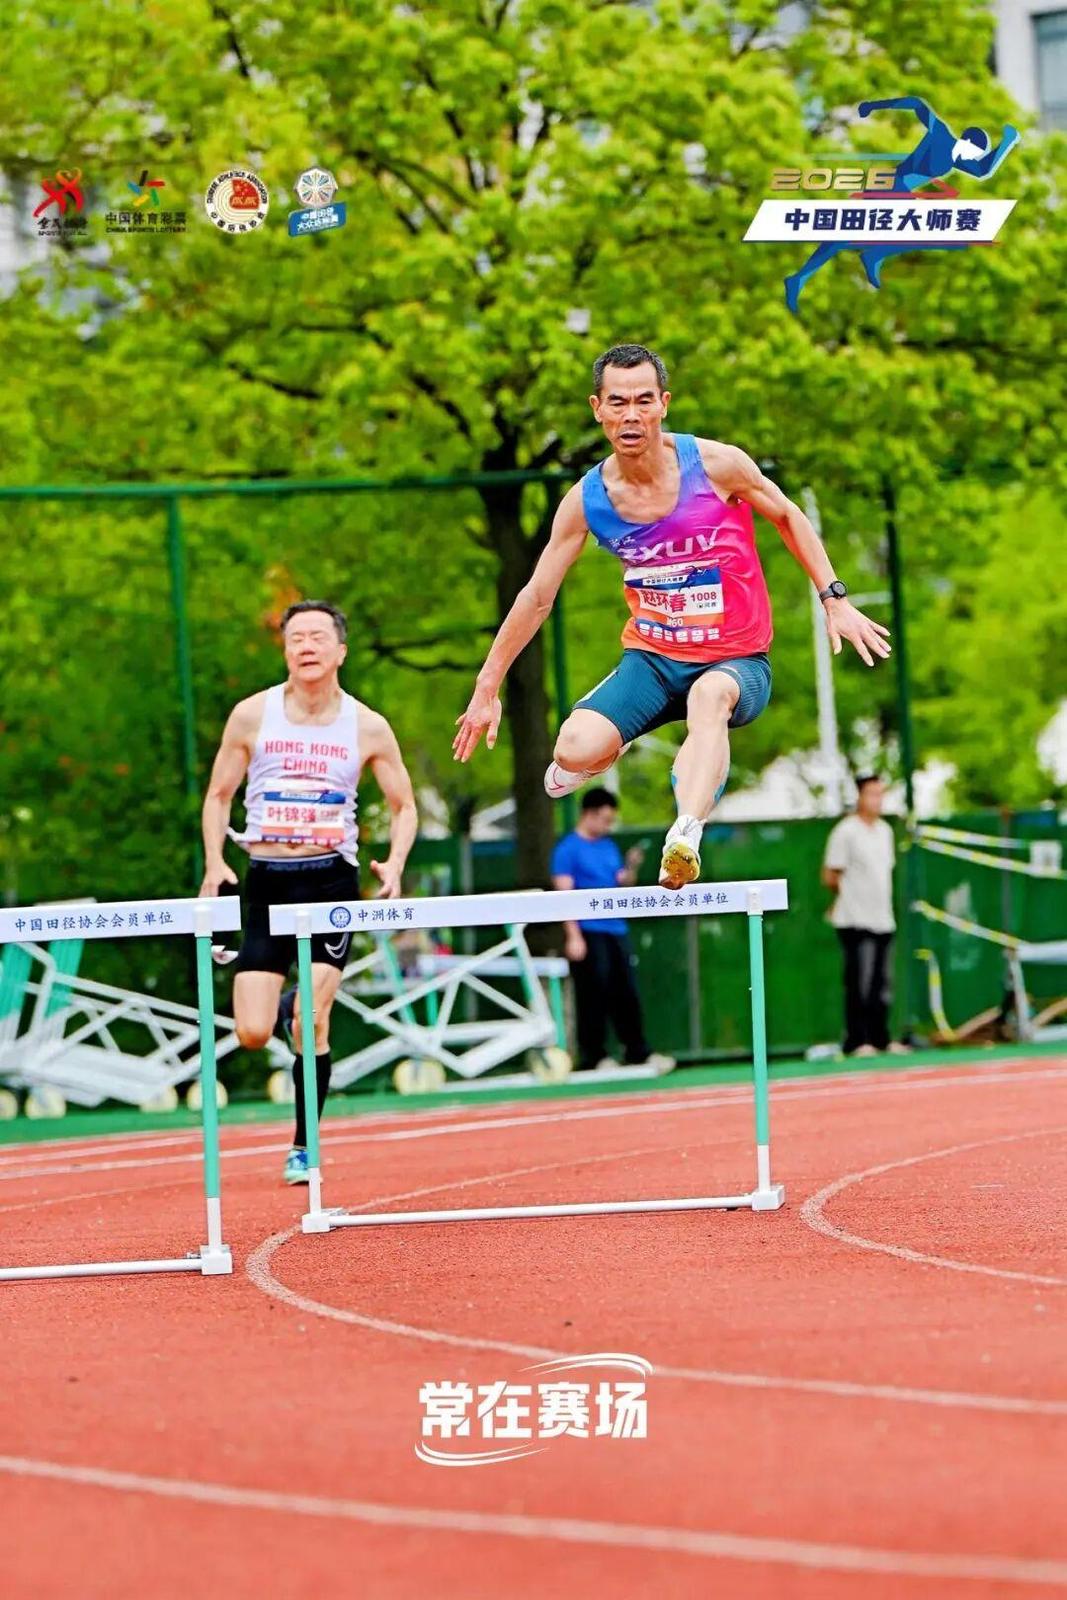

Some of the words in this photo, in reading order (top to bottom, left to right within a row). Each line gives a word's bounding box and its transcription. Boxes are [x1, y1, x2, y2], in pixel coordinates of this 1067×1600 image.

[690, 591, 717, 602] 1008
[265, 740, 304, 754] HONG
[310, 743, 348, 760] KONG
[283, 758, 328, 774] CHINA
[589, 893, 729, 912] 中国田径协会会员单位
[15, 911, 174, 932] 中国田径协会会员单位
[357, 907, 415, 922] 中洲体育
